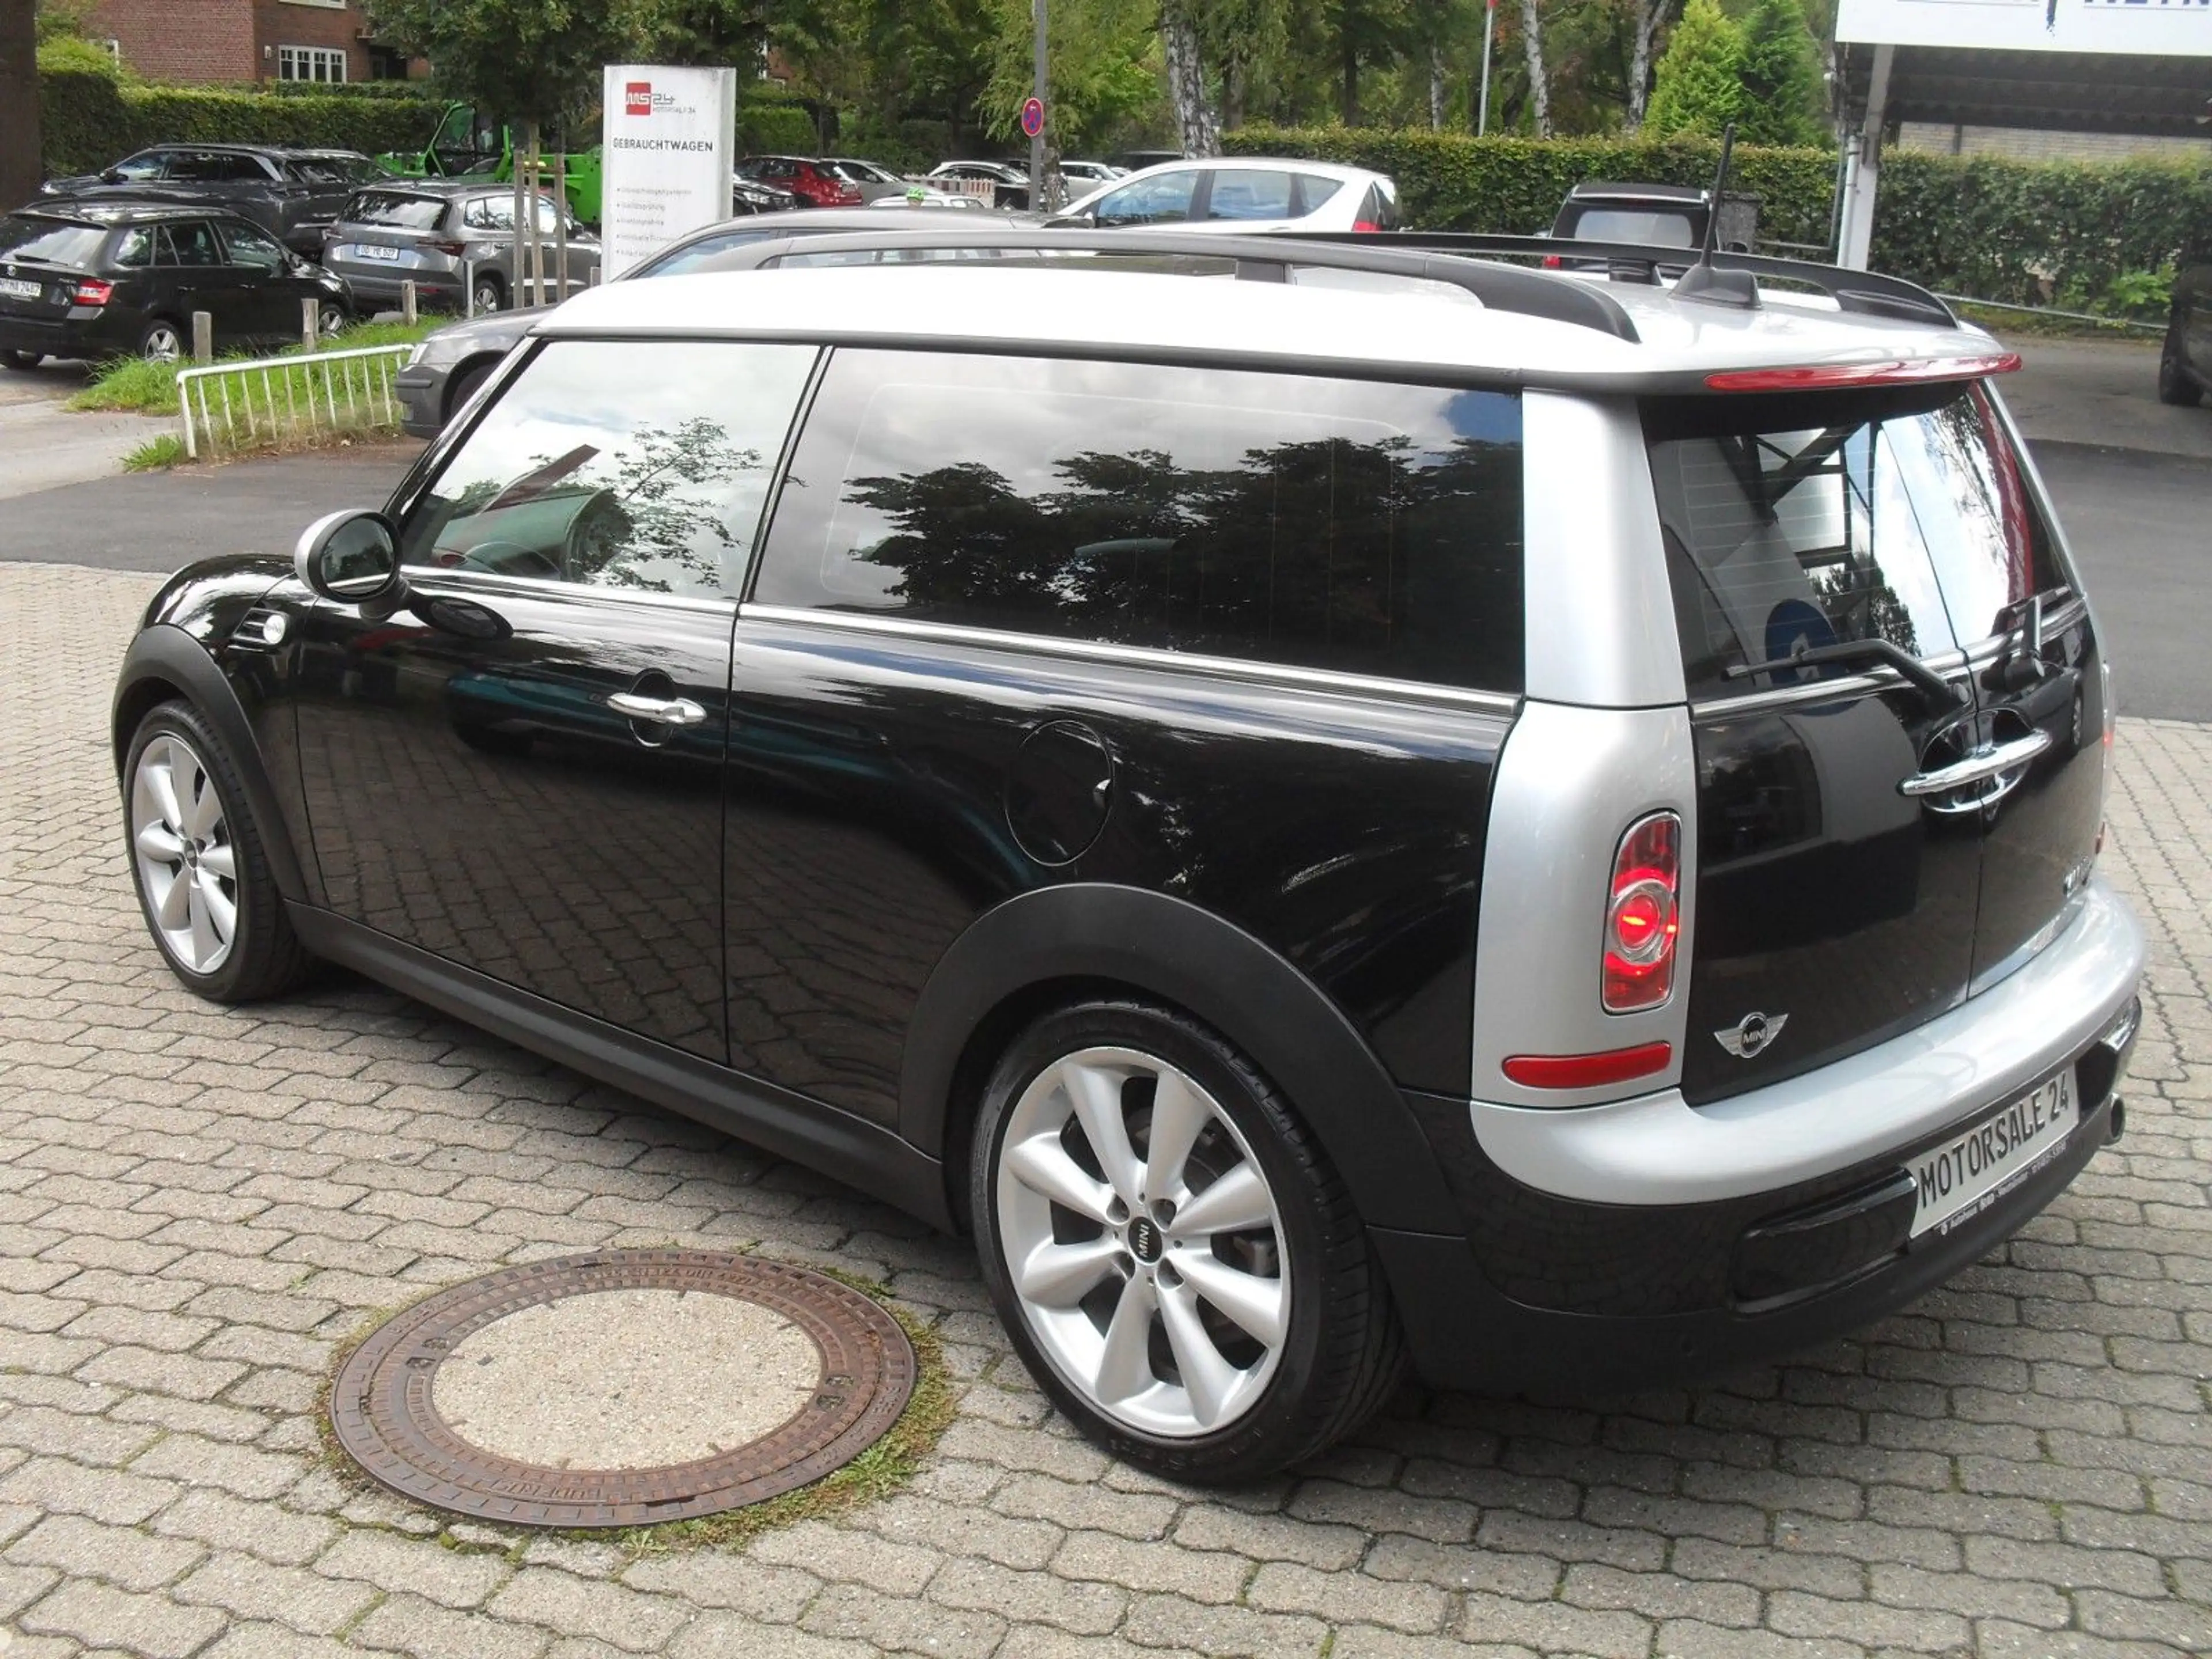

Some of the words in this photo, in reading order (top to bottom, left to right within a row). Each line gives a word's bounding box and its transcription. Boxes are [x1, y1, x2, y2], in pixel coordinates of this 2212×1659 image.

[613, 138, 713, 152] GEBRAUCHTWAGEN
[1919, 1090, 2045, 1209] MOTORSALE
[2048, 1071, 2069, 1122] 24
[1138, 1223, 1150, 1257] MINI
